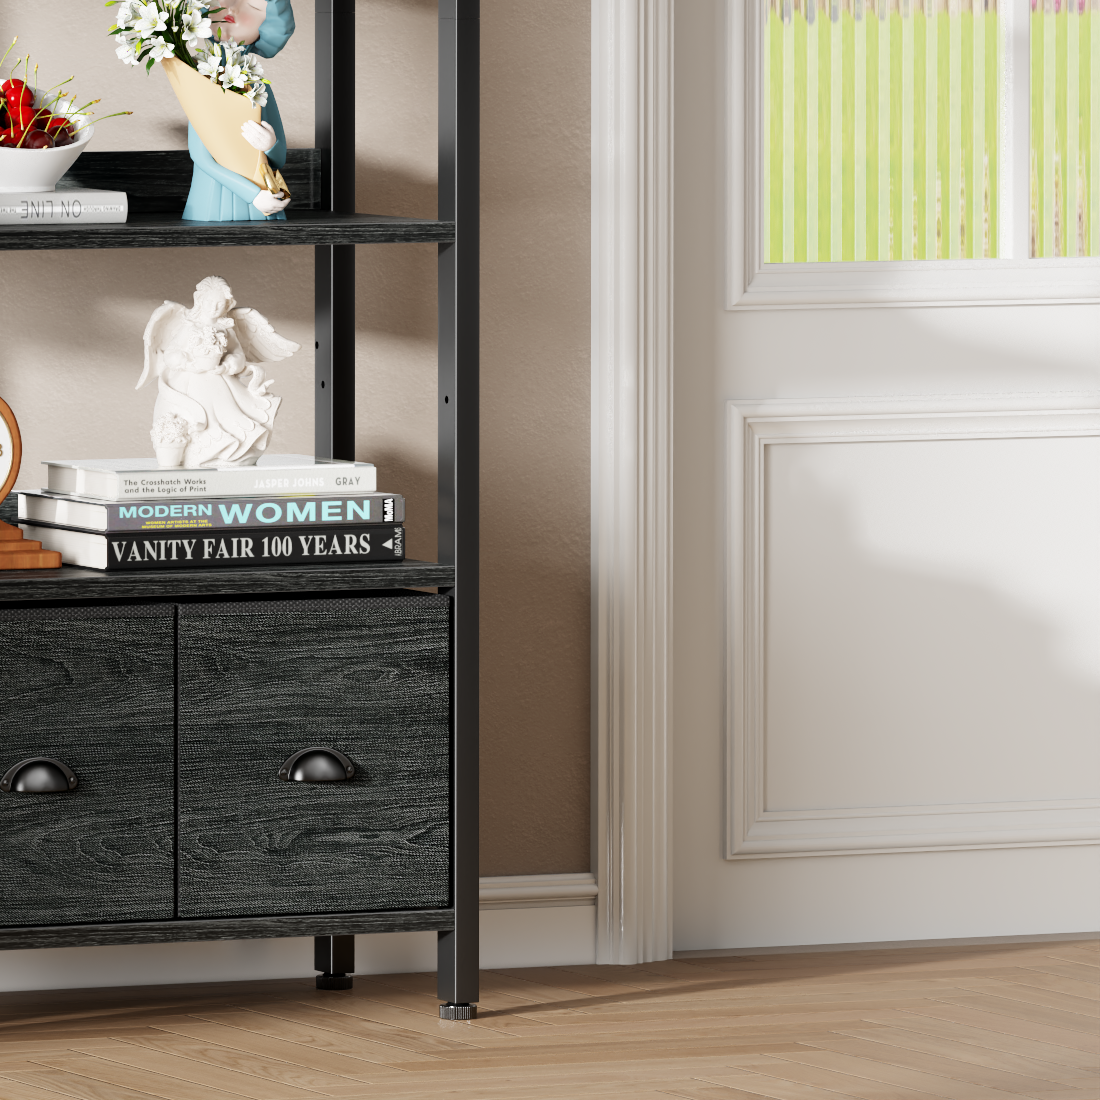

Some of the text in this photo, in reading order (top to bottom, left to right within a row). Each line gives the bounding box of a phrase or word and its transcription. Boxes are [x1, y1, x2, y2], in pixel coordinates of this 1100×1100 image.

[20, 199, 82, 219] ON LINE
[157, 486, 177, 495] Logic
[254, 476, 361, 490] JASPER JOHNS GRAY
[119, 500, 371, 524] MODERN WOMEN
[384, 498, 394, 522] MoMA
[111, 533, 371, 563] VANITY FAIR 100 YEARS
